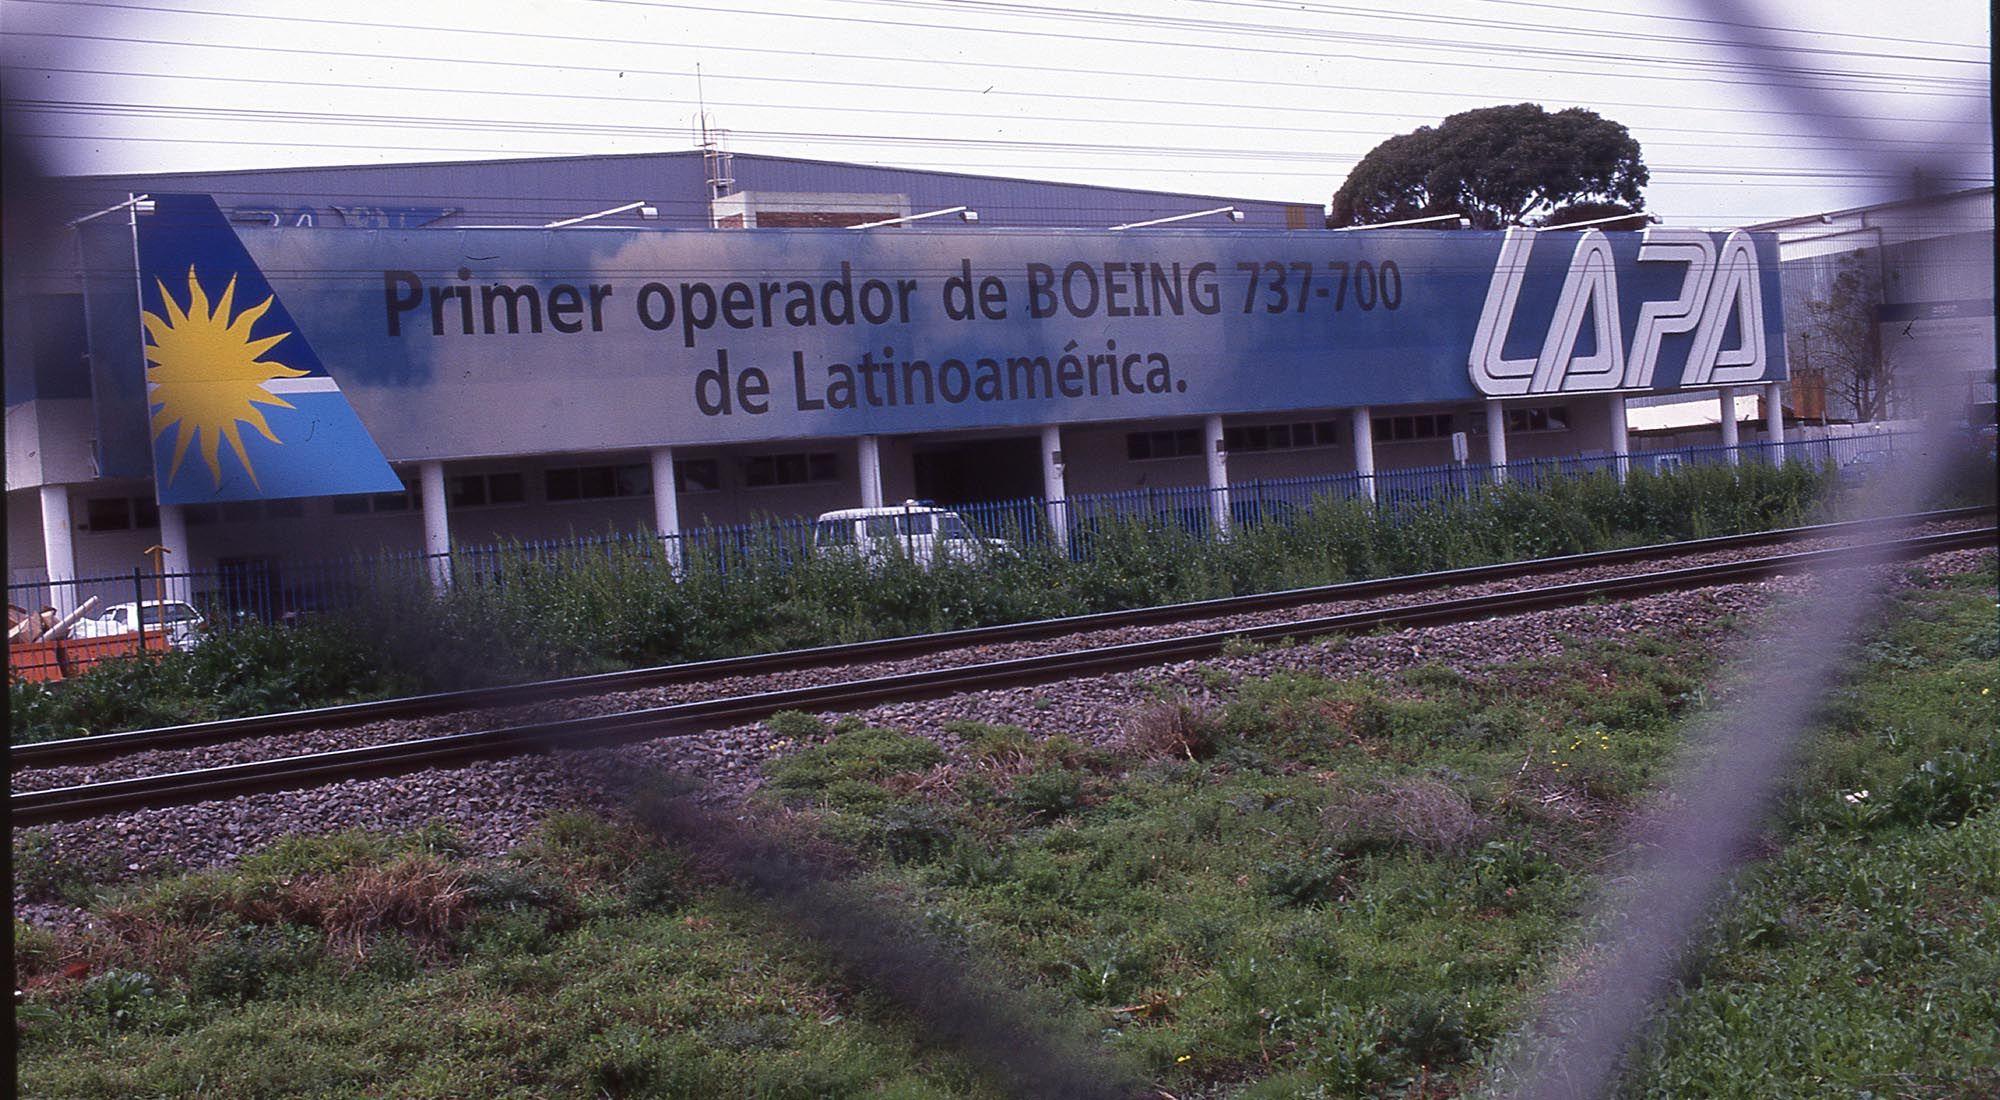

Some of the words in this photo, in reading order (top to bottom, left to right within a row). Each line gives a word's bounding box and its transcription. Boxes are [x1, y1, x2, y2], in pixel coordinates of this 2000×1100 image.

[385, 268, 612, 337] Primer
[637, 261, 917, 347] operador
[943, 258, 1008, 321] de
[1028, 261, 1221, 319] BOEING
[1237, 260, 1402, 313] 737-700
[1469, 225, 1766, 395] LAPA
[696, 348, 769, 417] de
[793, 340, 1188, 412] Latinoamérica.
